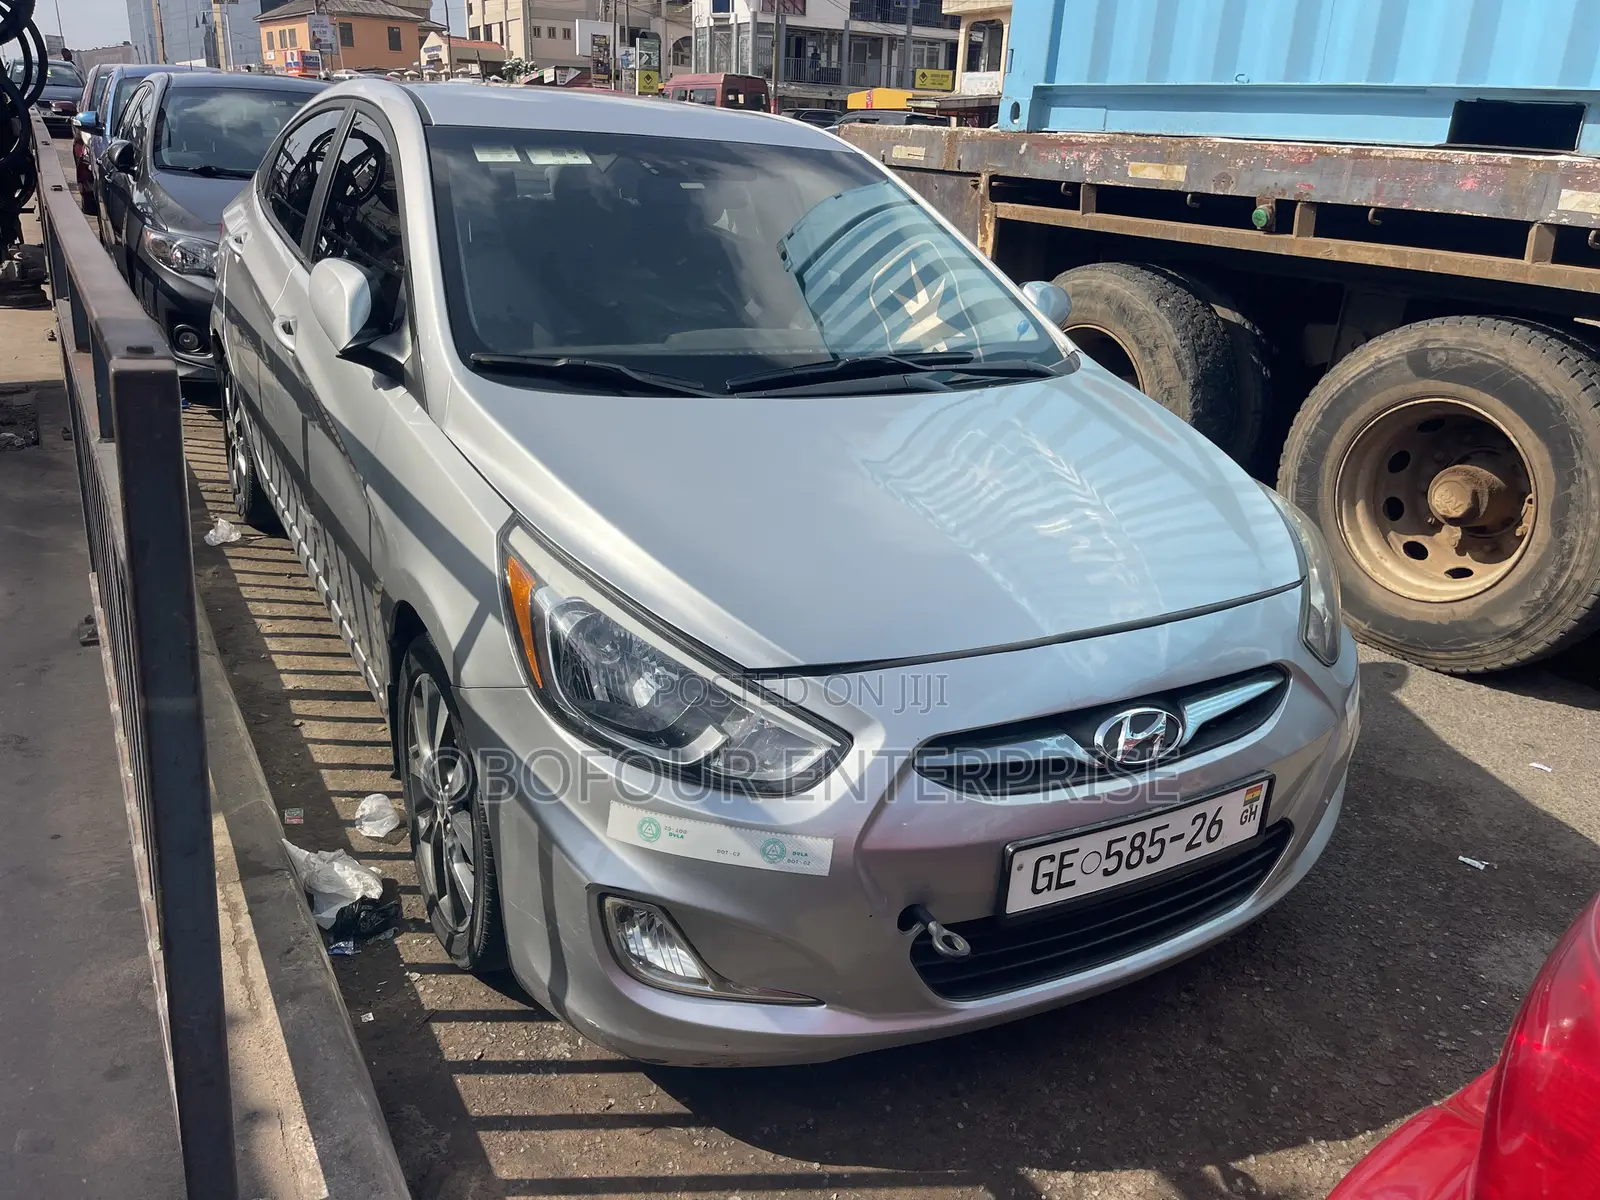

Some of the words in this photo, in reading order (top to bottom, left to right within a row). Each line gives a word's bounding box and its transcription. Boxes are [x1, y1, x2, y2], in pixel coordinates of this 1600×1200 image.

[1239, 804, 1258, 826] GH
[668, 831, 684, 839] DVLA
[1031, 848, 1079, 895] GE
[1102, 806, 1224, 877] 585-26
